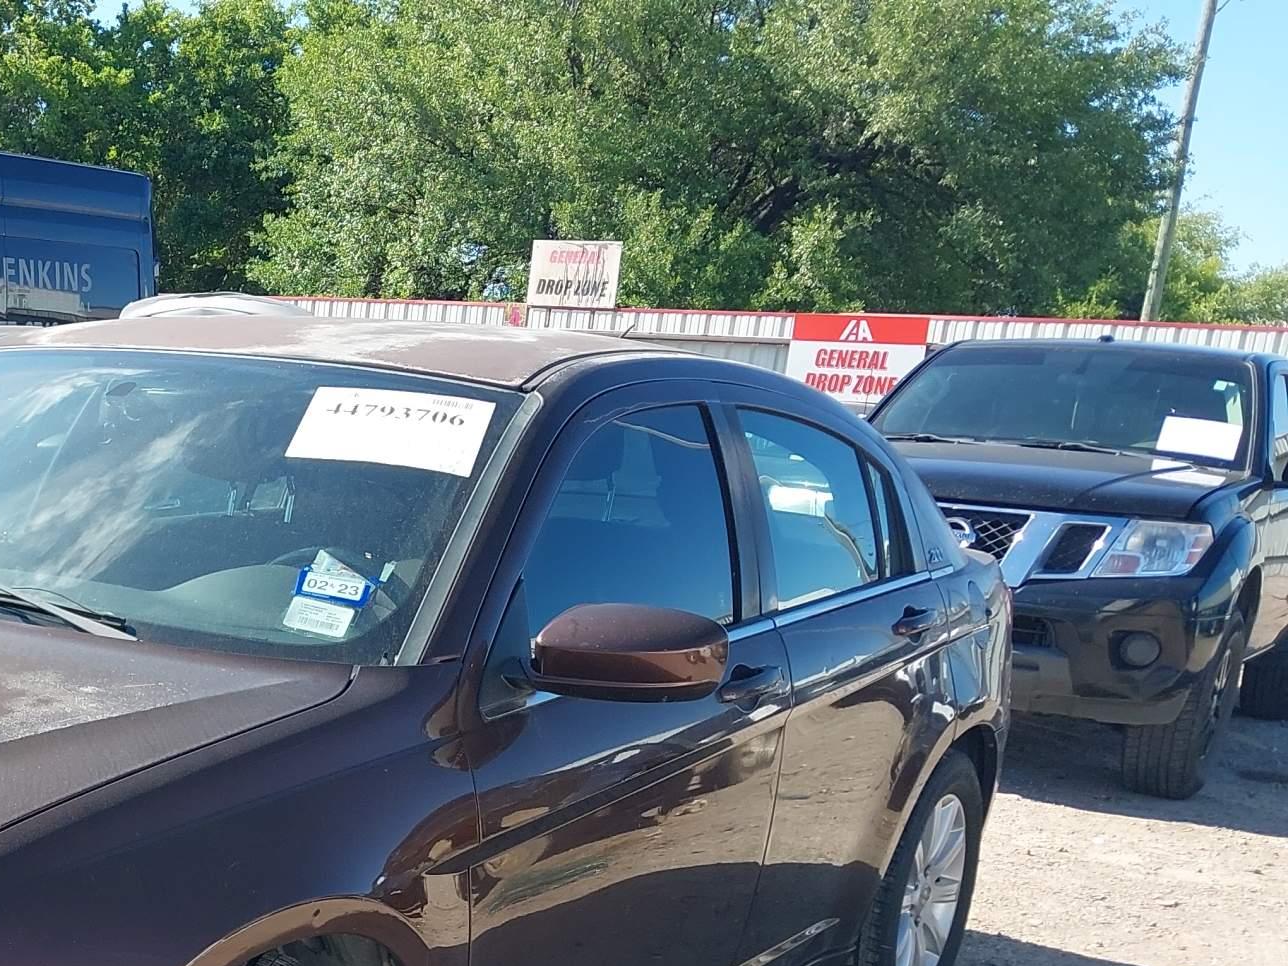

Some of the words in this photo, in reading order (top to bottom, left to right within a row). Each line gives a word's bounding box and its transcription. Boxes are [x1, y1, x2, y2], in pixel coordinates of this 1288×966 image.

[549, 249, 602, 265] GENERAL
[535, 278, 573, 297] DROP
[574, 279, 609, 298] ZONE
[815, 348, 890, 370] GENERAL
[805, 372, 852, 393] DROP
[852, 374, 898, 395] ZONE
[306, 578, 329, 591] 02
[336, 583, 360, 597] 23
